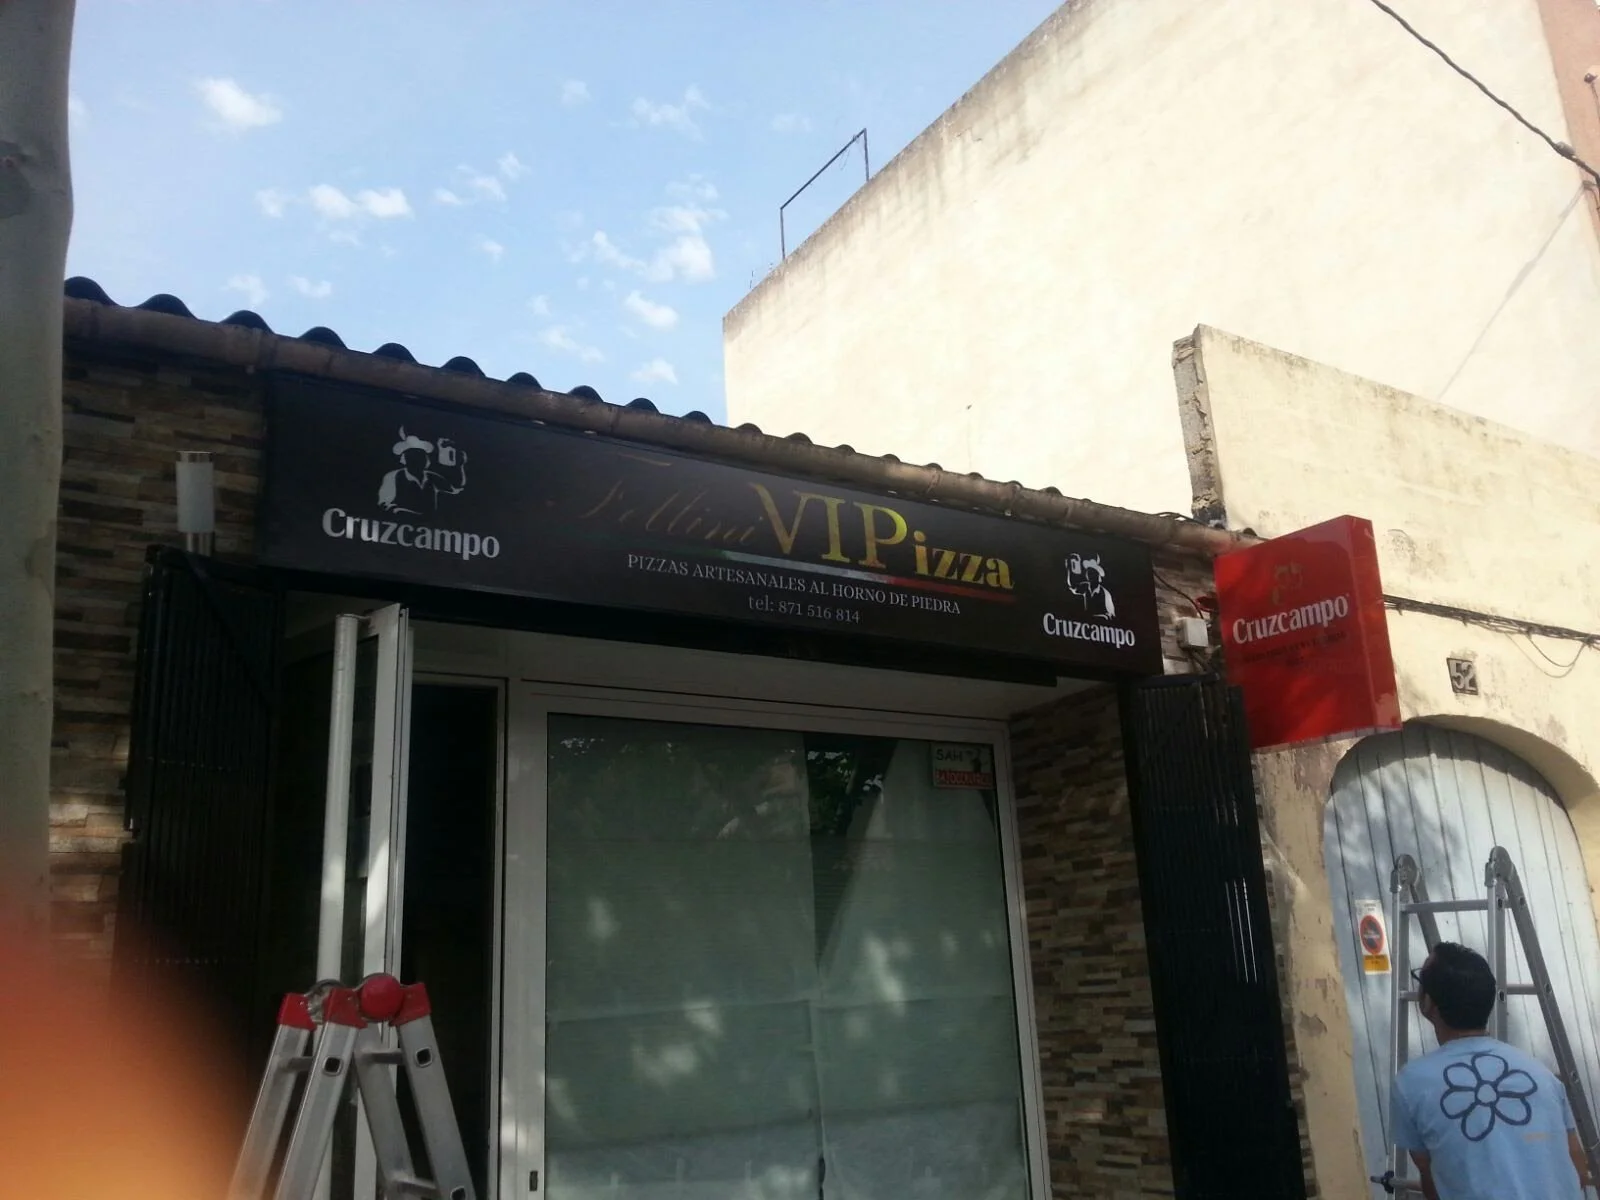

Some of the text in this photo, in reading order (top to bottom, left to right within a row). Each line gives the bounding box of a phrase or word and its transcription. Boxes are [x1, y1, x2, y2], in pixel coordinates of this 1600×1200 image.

[322, 507, 501, 561] Cruzcampo
[627, 553, 962, 616] PIZZAS ARTESANALES AL HORNO DE PIEDRA
[748, 593, 862, 625] tel: 871 516 814
[1042, 612, 1137, 649] Cruzcampo
[1232, 594, 1350, 645] Cruzcampo
